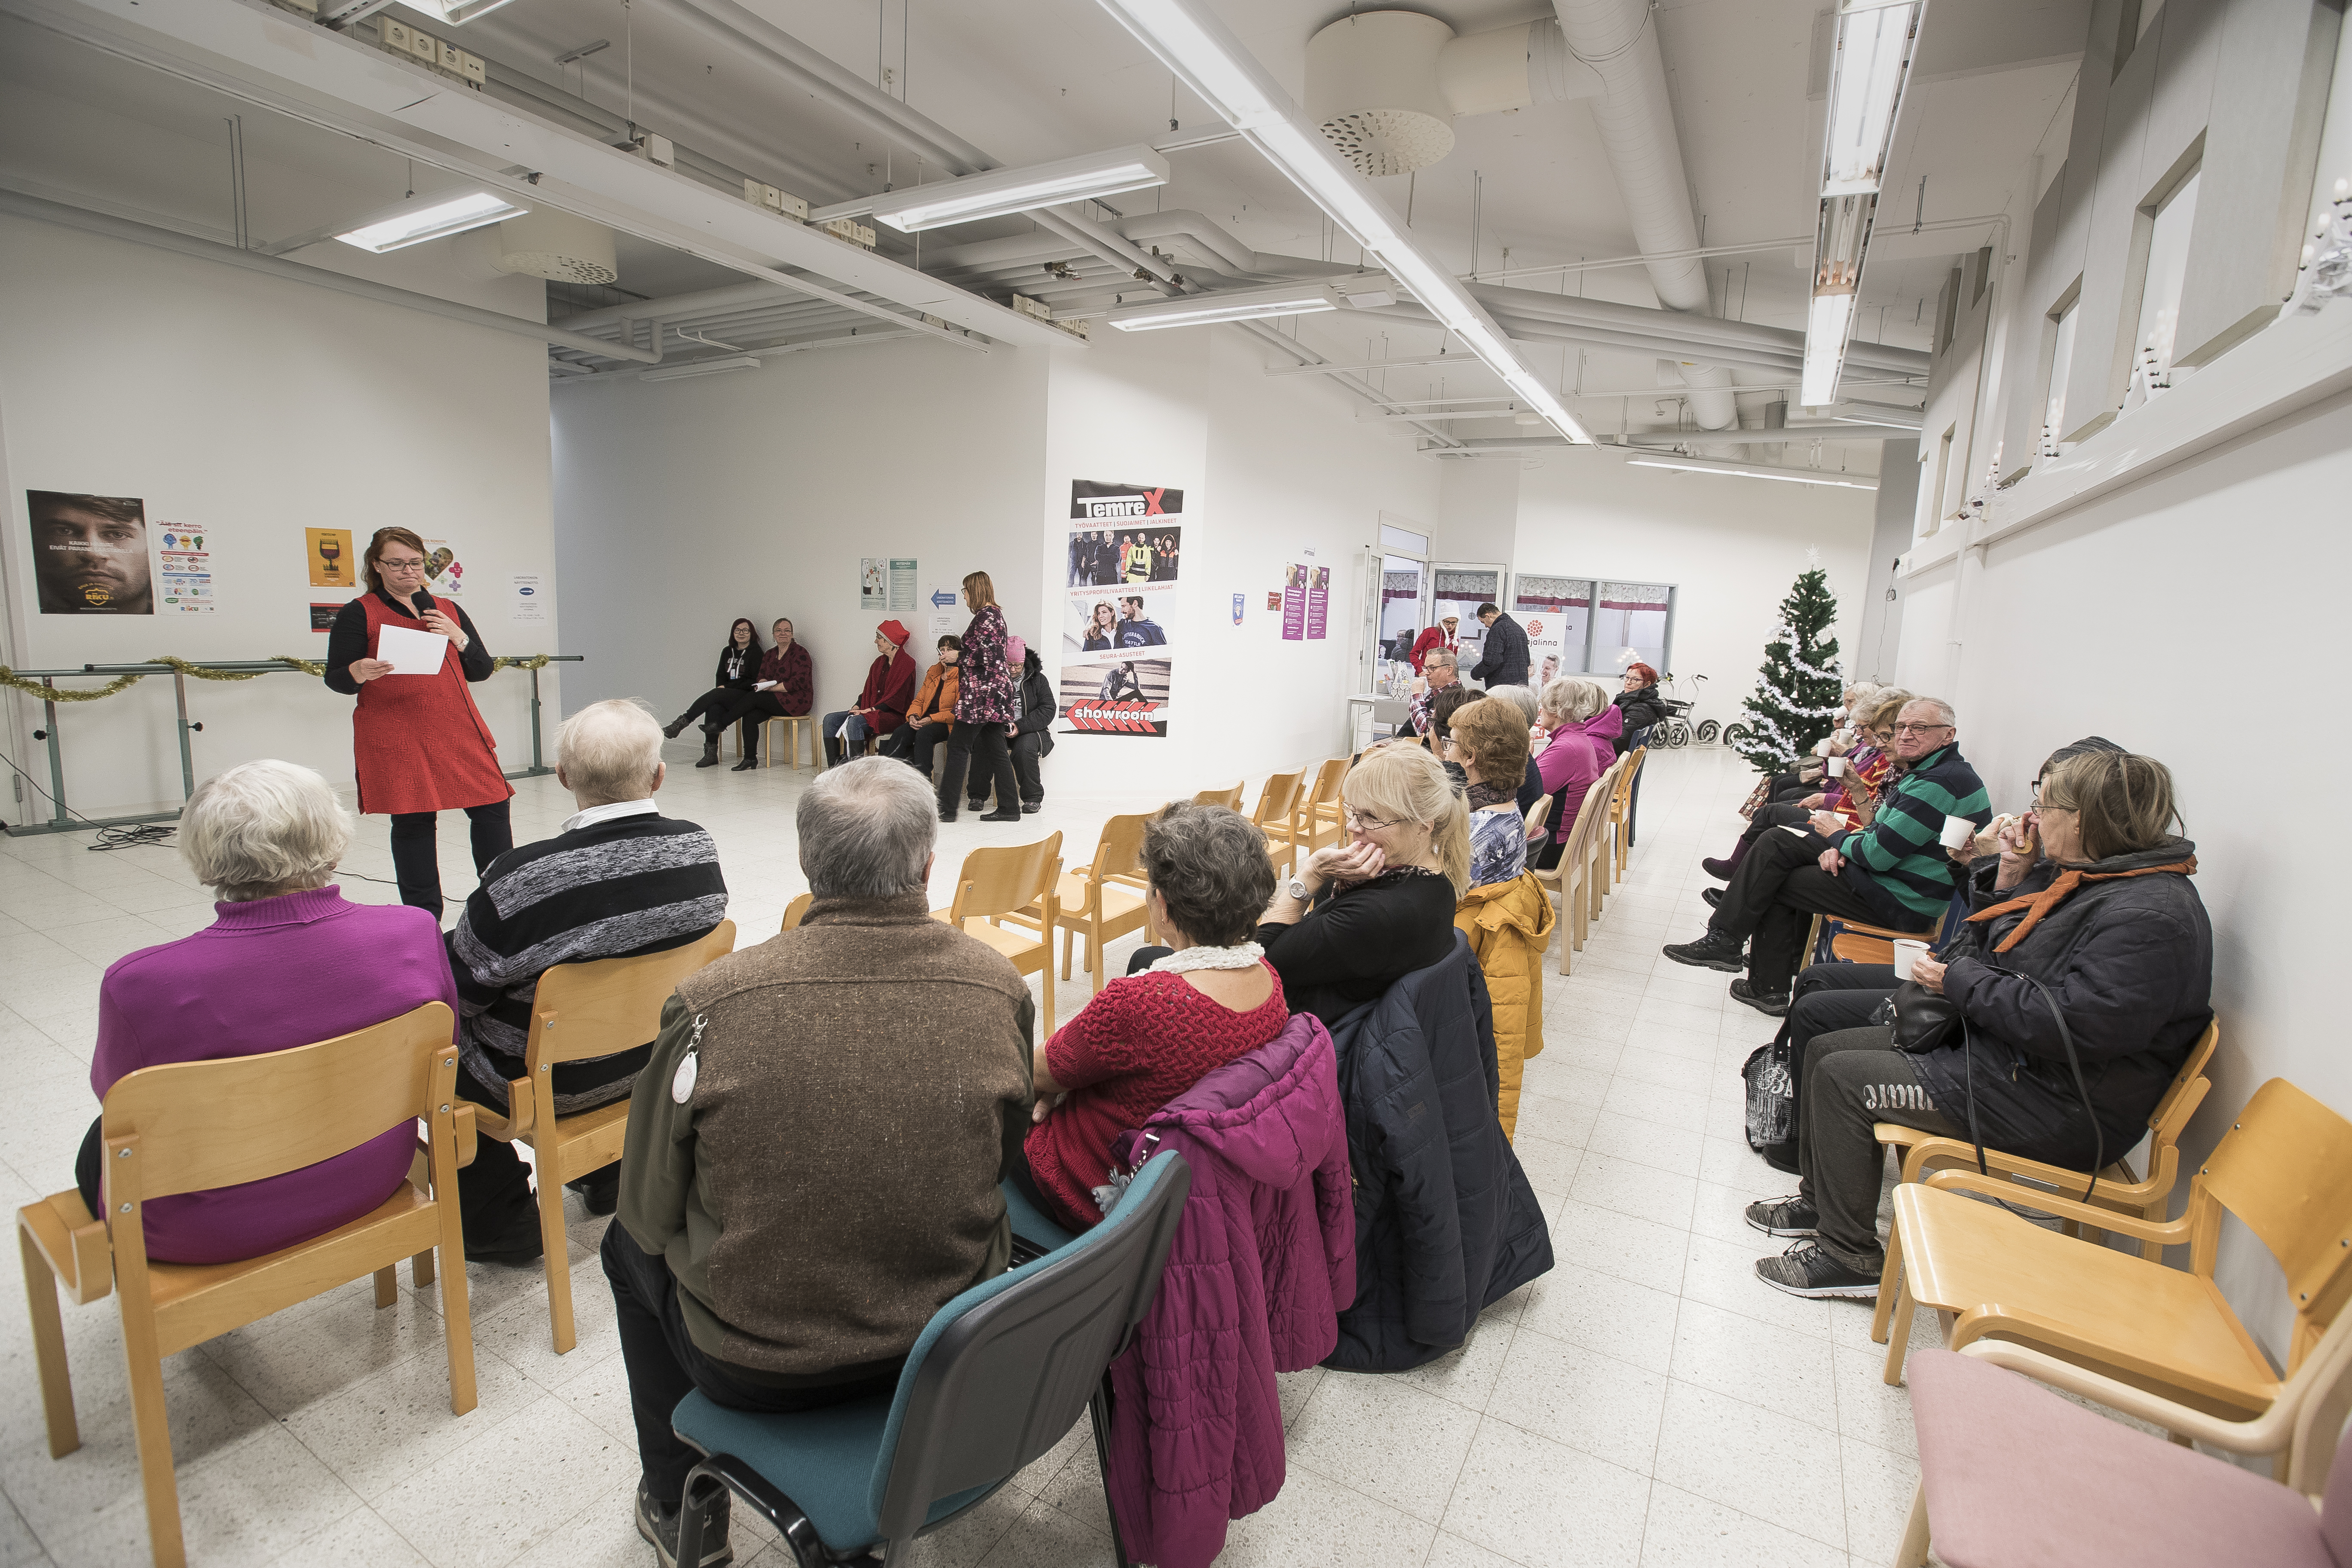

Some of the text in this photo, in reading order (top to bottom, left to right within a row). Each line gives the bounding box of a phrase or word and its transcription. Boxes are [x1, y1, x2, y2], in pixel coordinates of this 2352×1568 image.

[1077, 488, 1165, 517] TemreX
[1070, 587, 1138, 597] YRITYSPROFIILIVAATTEET
[1099, 651, 1145, 659] SEURA-ASUSTEET
[1074, 706, 1154, 721] showroom
